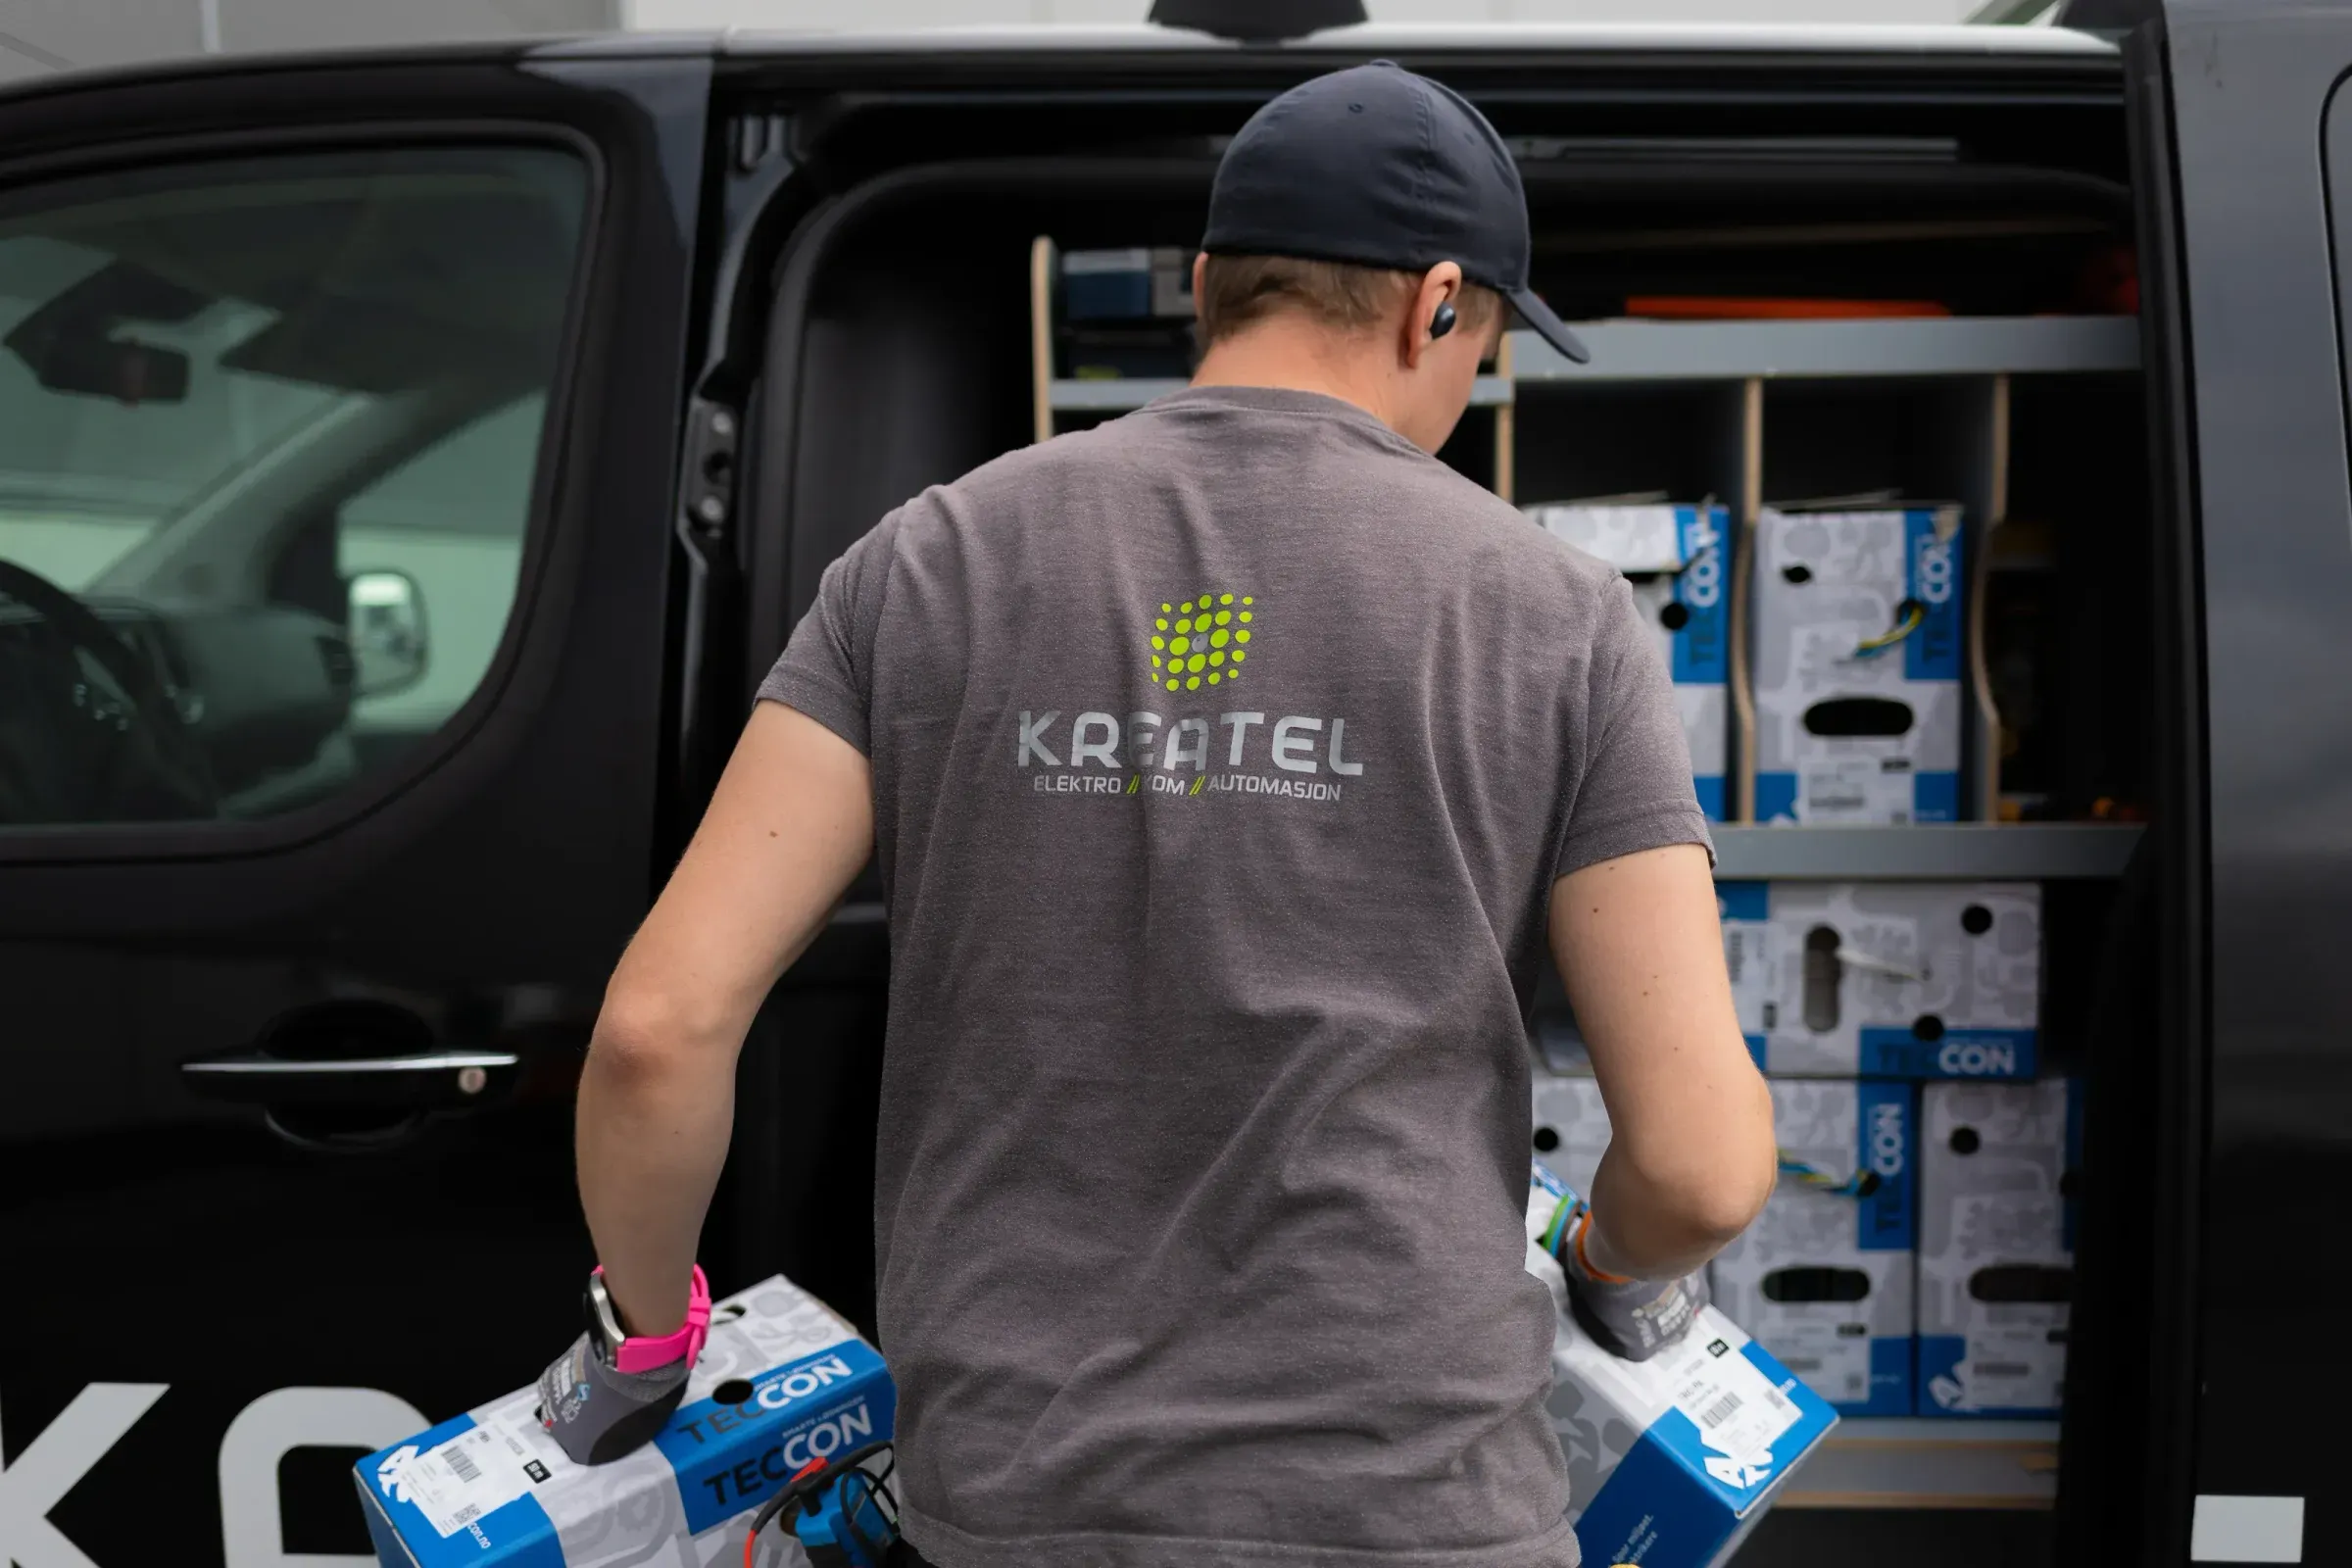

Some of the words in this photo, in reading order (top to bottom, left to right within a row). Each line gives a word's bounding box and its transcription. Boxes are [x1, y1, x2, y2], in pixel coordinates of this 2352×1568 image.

[1017, 710, 1363, 776] KREATEL
[1034, 774, 1121, 794] ELEKTRO
[1207, 774, 1341, 801] AUTOMASJON
[676, 1357, 853, 1444] TECCON
[703, 1403, 872, 1505] TECCON
